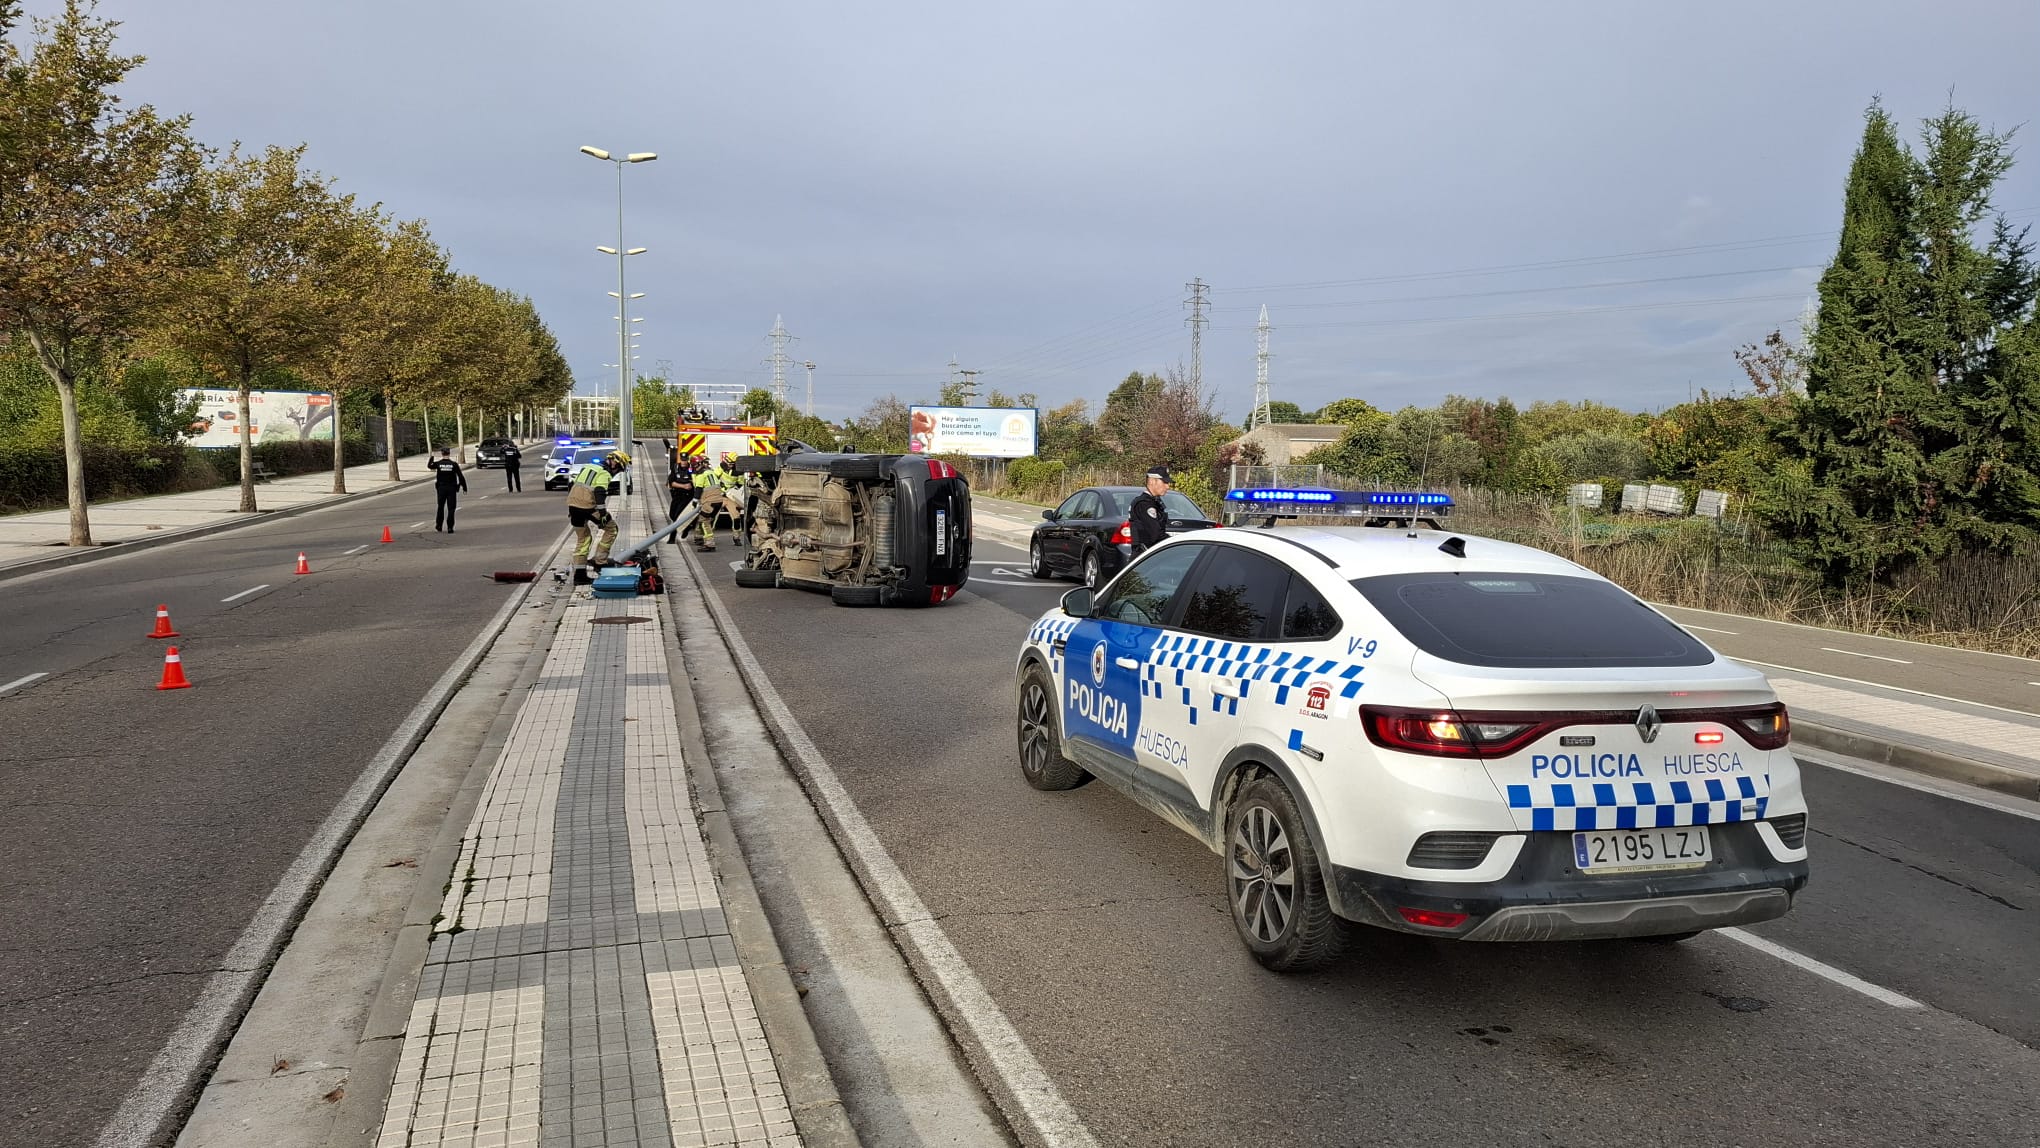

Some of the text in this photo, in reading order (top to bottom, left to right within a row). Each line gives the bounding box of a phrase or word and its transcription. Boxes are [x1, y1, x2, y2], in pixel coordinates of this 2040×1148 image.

[941, 415, 953, 423] Hay
[1347, 636, 1378, 659] V-9
[1069, 678, 1128, 739] POLICIA
[1310, 695, 1323, 708] 112
[1139, 727, 1188, 769] HUESCA
[1531, 752, 1743, 779] POLICIA HUESCA
[1592, 831, 1706, 863] 2195 LZJ
